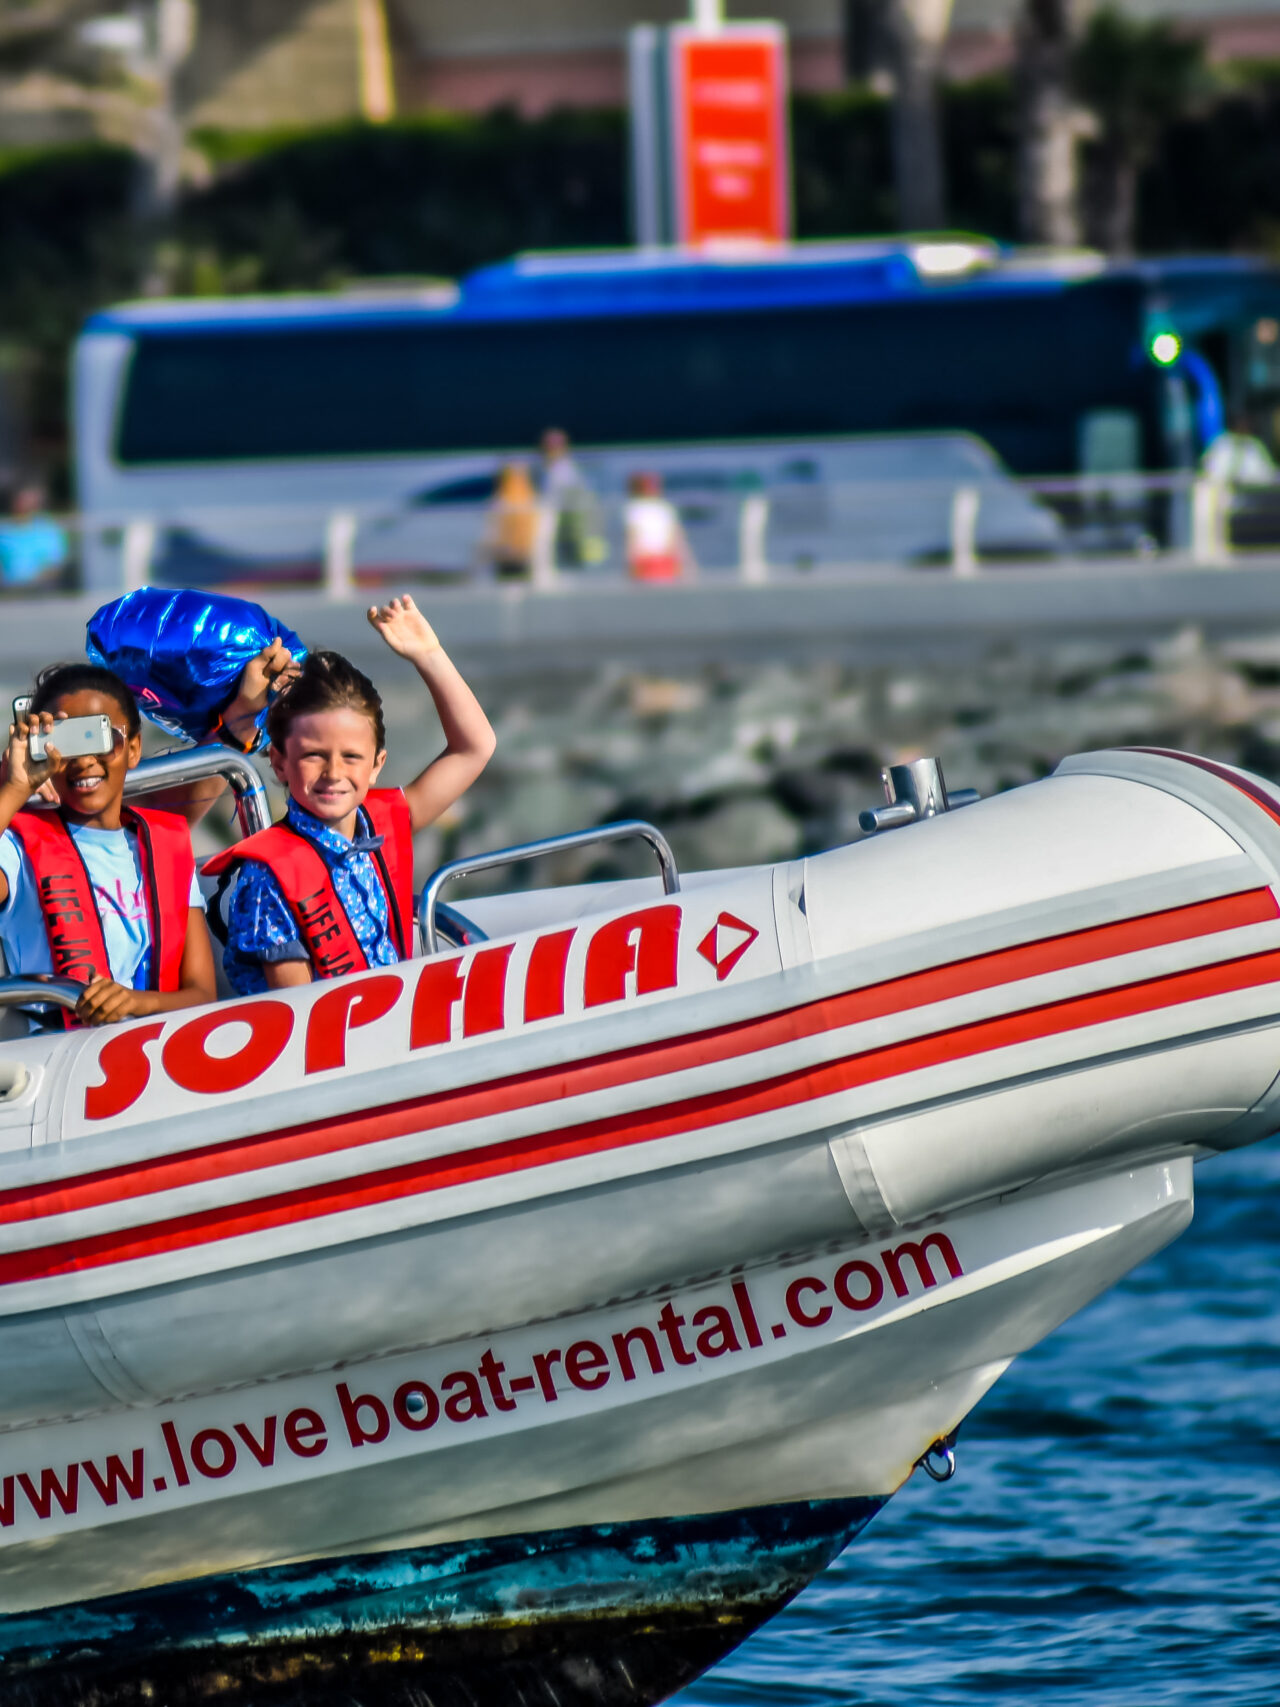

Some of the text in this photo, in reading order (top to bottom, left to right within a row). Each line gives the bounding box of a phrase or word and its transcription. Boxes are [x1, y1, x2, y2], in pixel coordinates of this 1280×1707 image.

[39, 874, 85, 927] LIFE
[297, 887, 341, 949] LIFE
[84, 903, 684, 1121] SOPHIA
